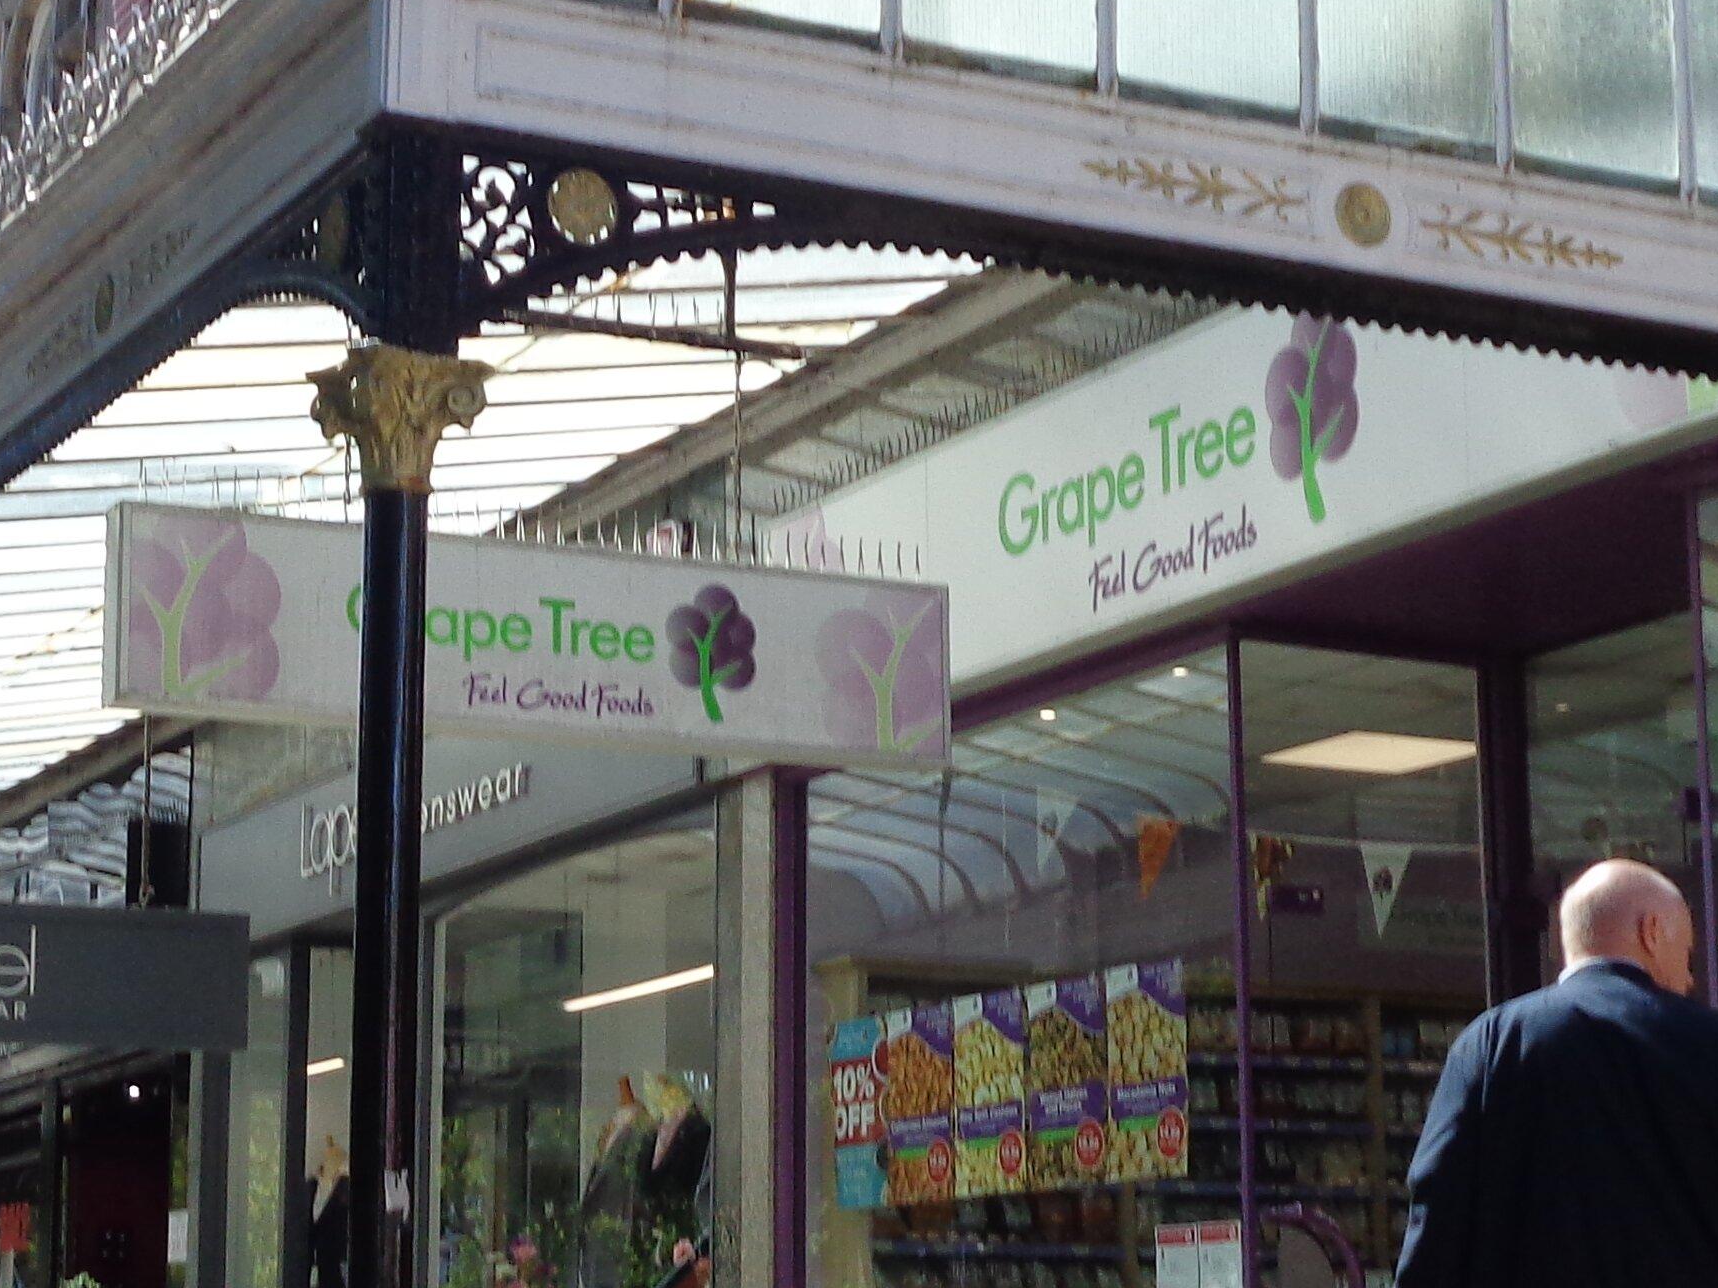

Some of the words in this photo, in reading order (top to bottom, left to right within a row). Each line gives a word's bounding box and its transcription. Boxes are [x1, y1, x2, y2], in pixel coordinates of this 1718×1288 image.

[998, 451, 1145, 557] Grape
[1149, 404, 1256, 495] Tree
[1089, 549, 1126, 613] Feel
[1133, 522, 1194, 593] Good
[1198, 503, 1258, 574] Foods
[539, 596, 655, 662] Tree
[463, 670, 508, 708] Feel
[516, 678, 587, 712] Good
[591, 682, 655, 719] Foods
[834, 1062, 876, 1102] 10%
[834, 1102, 876, 1139] OFF
